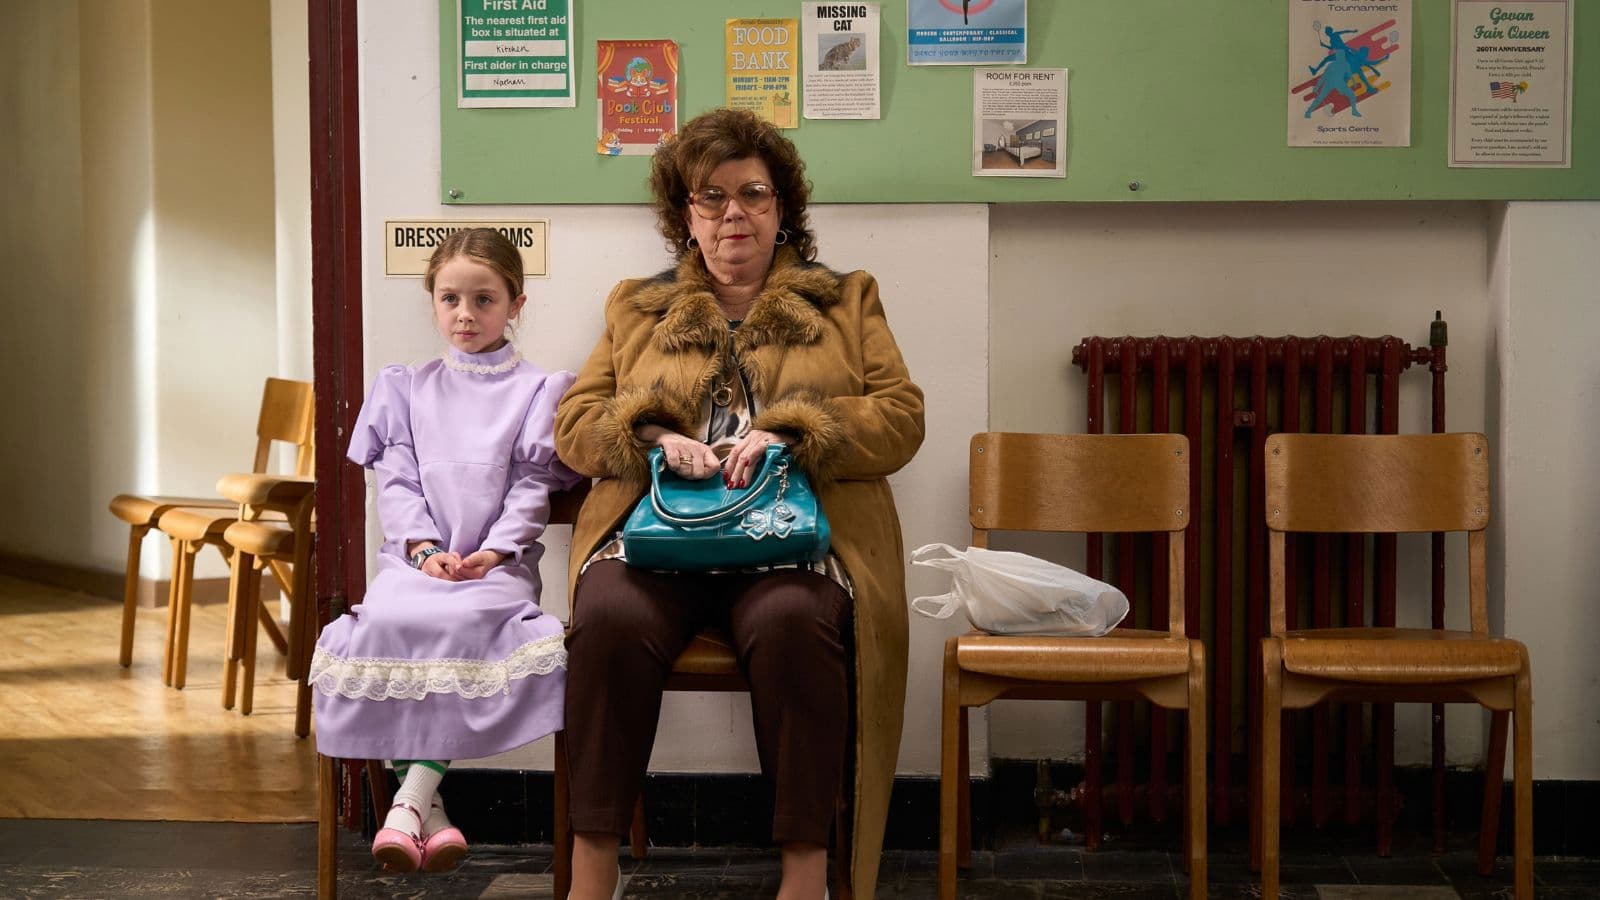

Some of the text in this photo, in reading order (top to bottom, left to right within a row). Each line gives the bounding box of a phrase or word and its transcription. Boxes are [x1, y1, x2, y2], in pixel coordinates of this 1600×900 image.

[483, 0, 547, 10] First Aid
[1327, 4, 1399, 12] Tournament
[817, 5, 867, 19] MISSING
[1490, 7, 1535, 25] Govan
[465, 15, 566, 25] The nearest first aid
[833, 20, 852, 31] CAT
[472, 28, 559, 37] box is situated at
[733, 26, 789, 46] FOOD
[1474, 25, 1550, 39] Fair Queen
[465, 60, 567, 72] First aider in charge
[732, 51, 790, 70] BANK
[986, 72, 1011, 80] ROOM
[607, 99, 672, 115] Book Club
[619, 115, 659, 124] Festival
[1317, 125, 1347, 133] Sports
[394, 227, 461, 248] DRESSI
